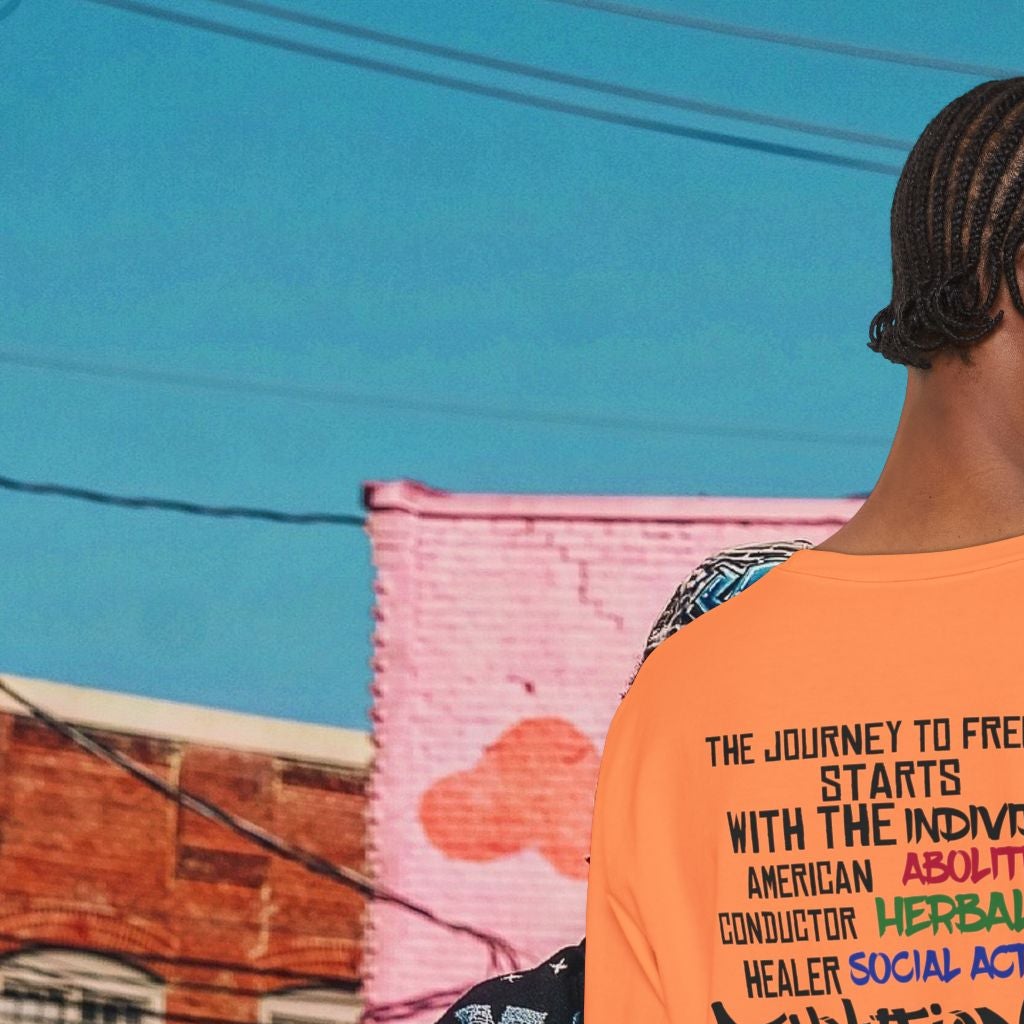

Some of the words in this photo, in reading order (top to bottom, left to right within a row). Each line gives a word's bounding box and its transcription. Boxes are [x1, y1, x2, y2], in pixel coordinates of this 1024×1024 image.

[705, 734, 754, 766] THE
[765, 721, 901, 761] JOURNEY
[914, 719, 950, 752] TO
[821, 759, 960, 802] STARTS
[727, 808, 805, 853] WITH
[817, 802, 896, 849] THE
[748, 860, 873, 899] AMERICAN
[718, 907, 857, 945] CONDUCTOR
[743, 956, 842, 998] HEALER
[848, 947, 961, 985] SOCIAL
